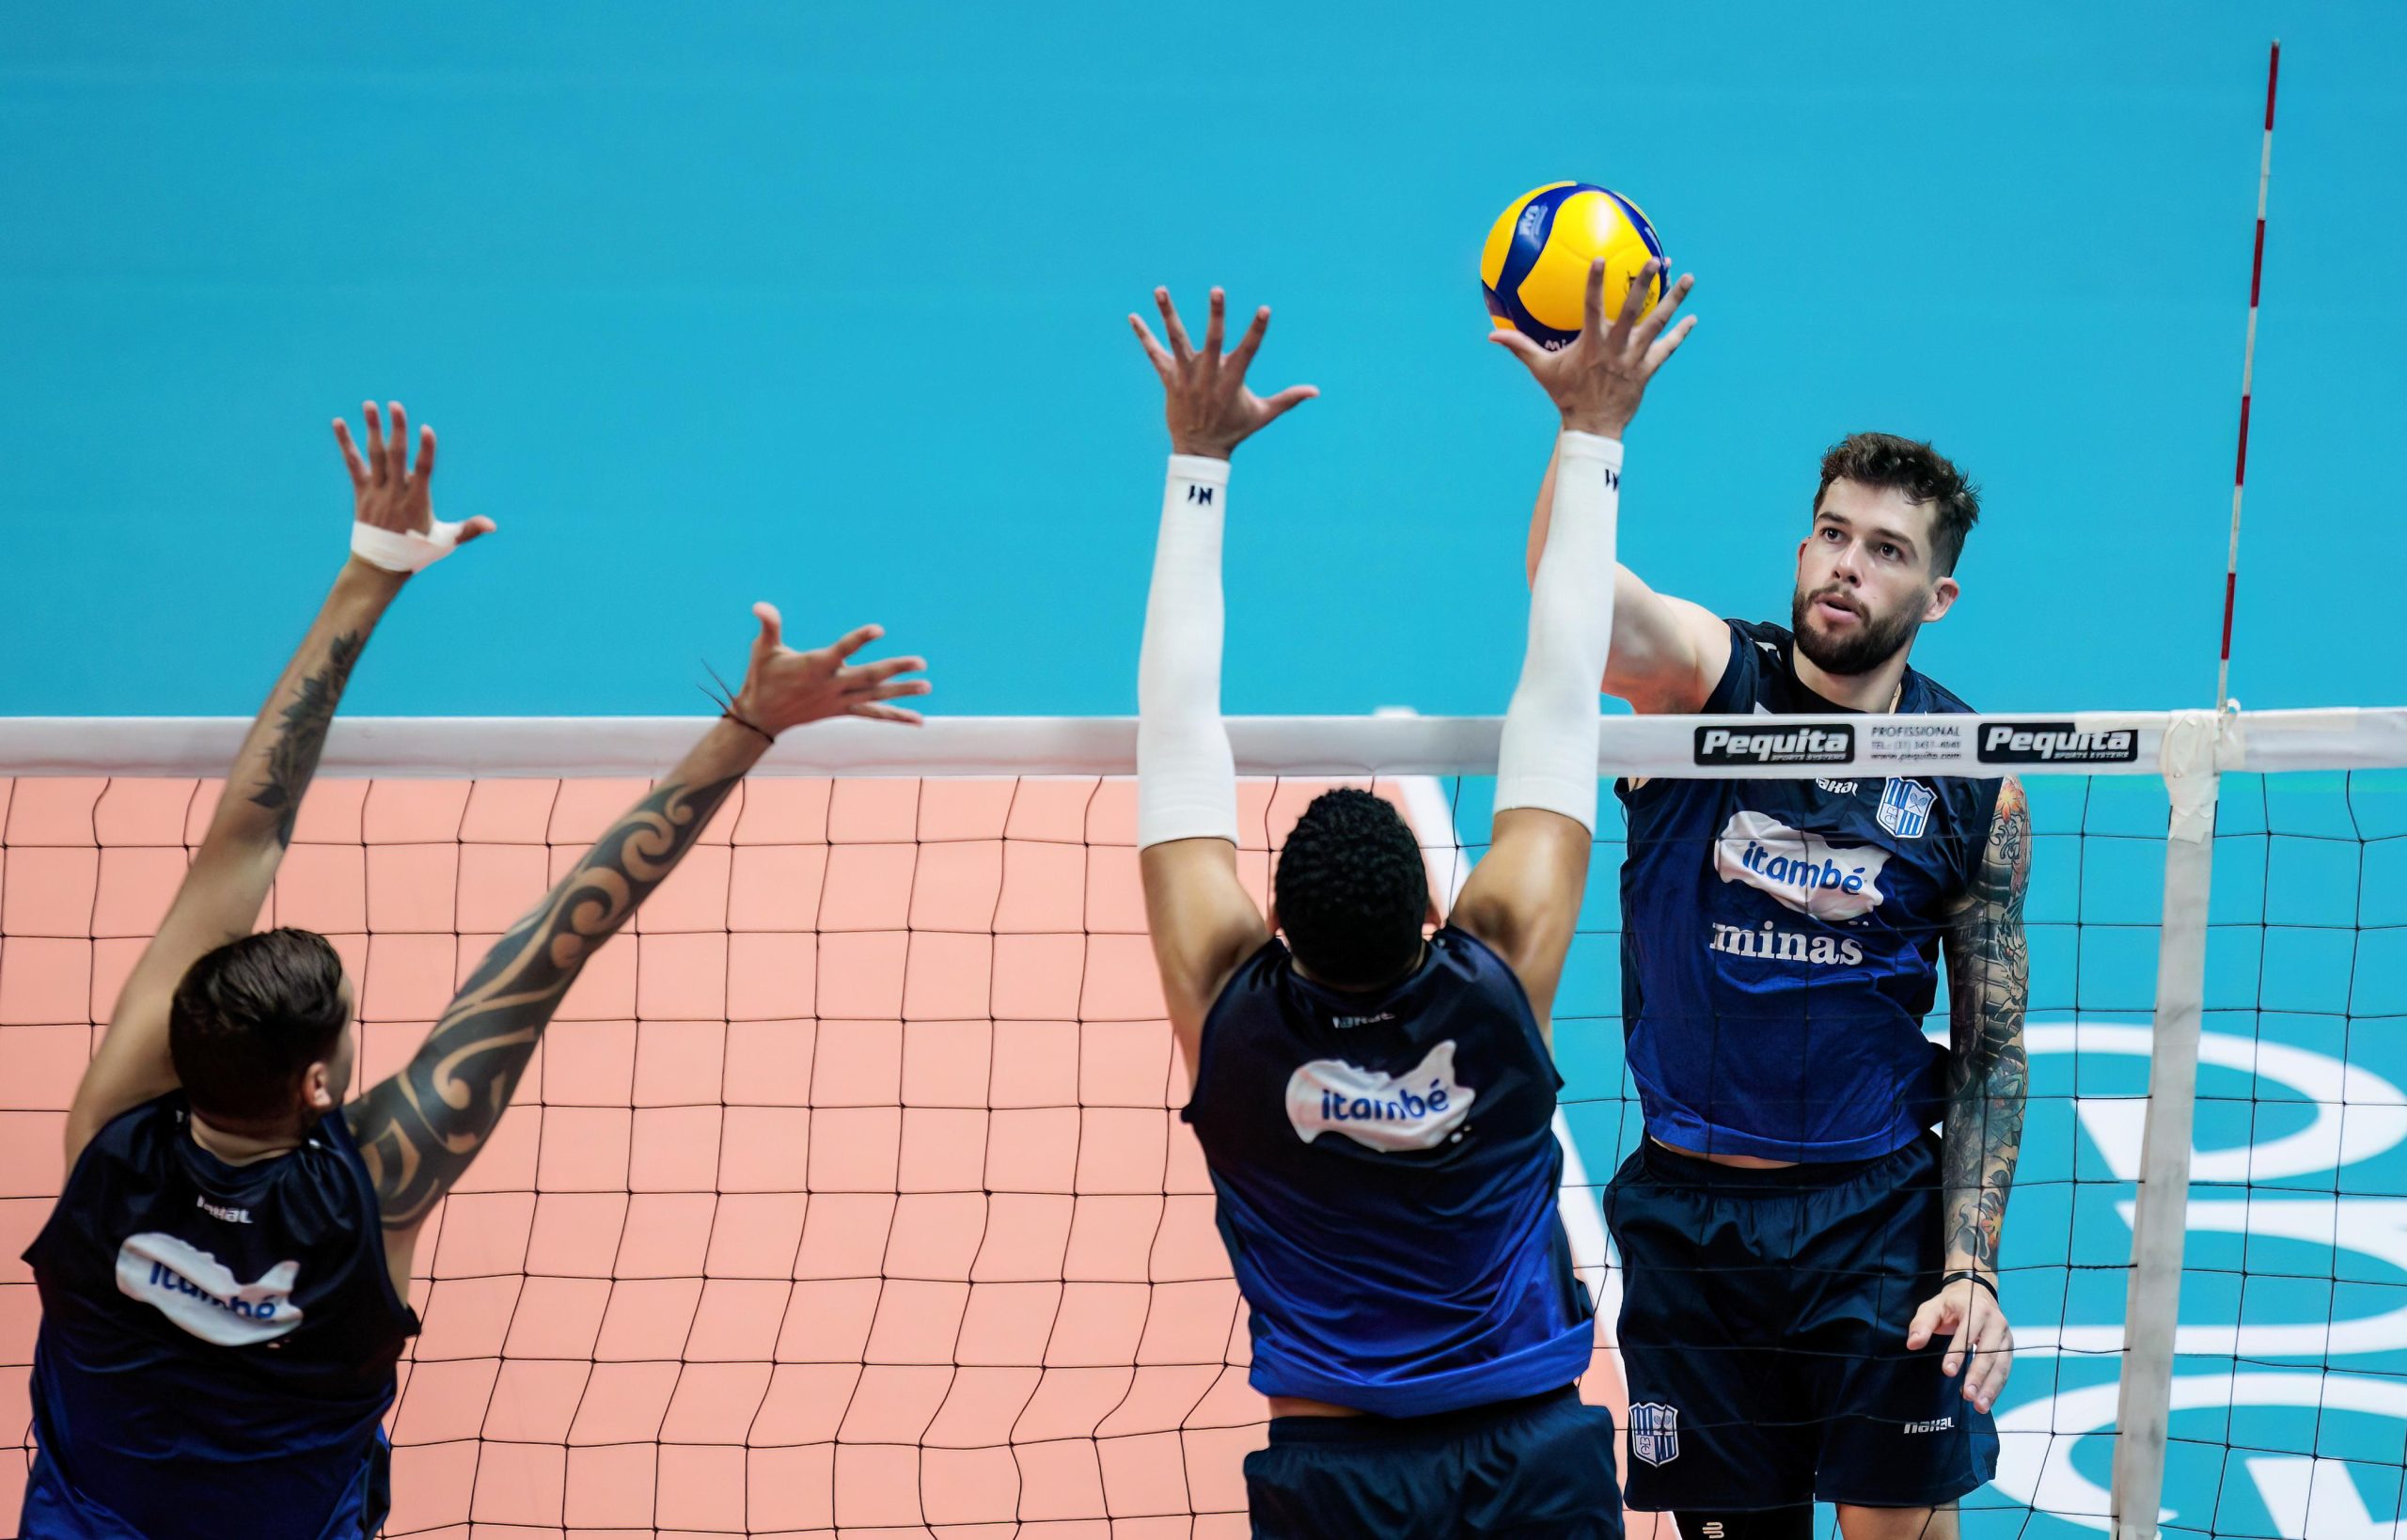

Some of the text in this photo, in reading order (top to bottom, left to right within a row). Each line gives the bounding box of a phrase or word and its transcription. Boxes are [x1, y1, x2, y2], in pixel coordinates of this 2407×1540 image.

[1702, 728, 1849, 762] Pequita
[1986, 726, 2132, 760] Pequita
[1742, 841, 1865, 895] itambé
[1709, 919, 1864, 966] minas
[1321, 1077, 1450, 1122] itambé
